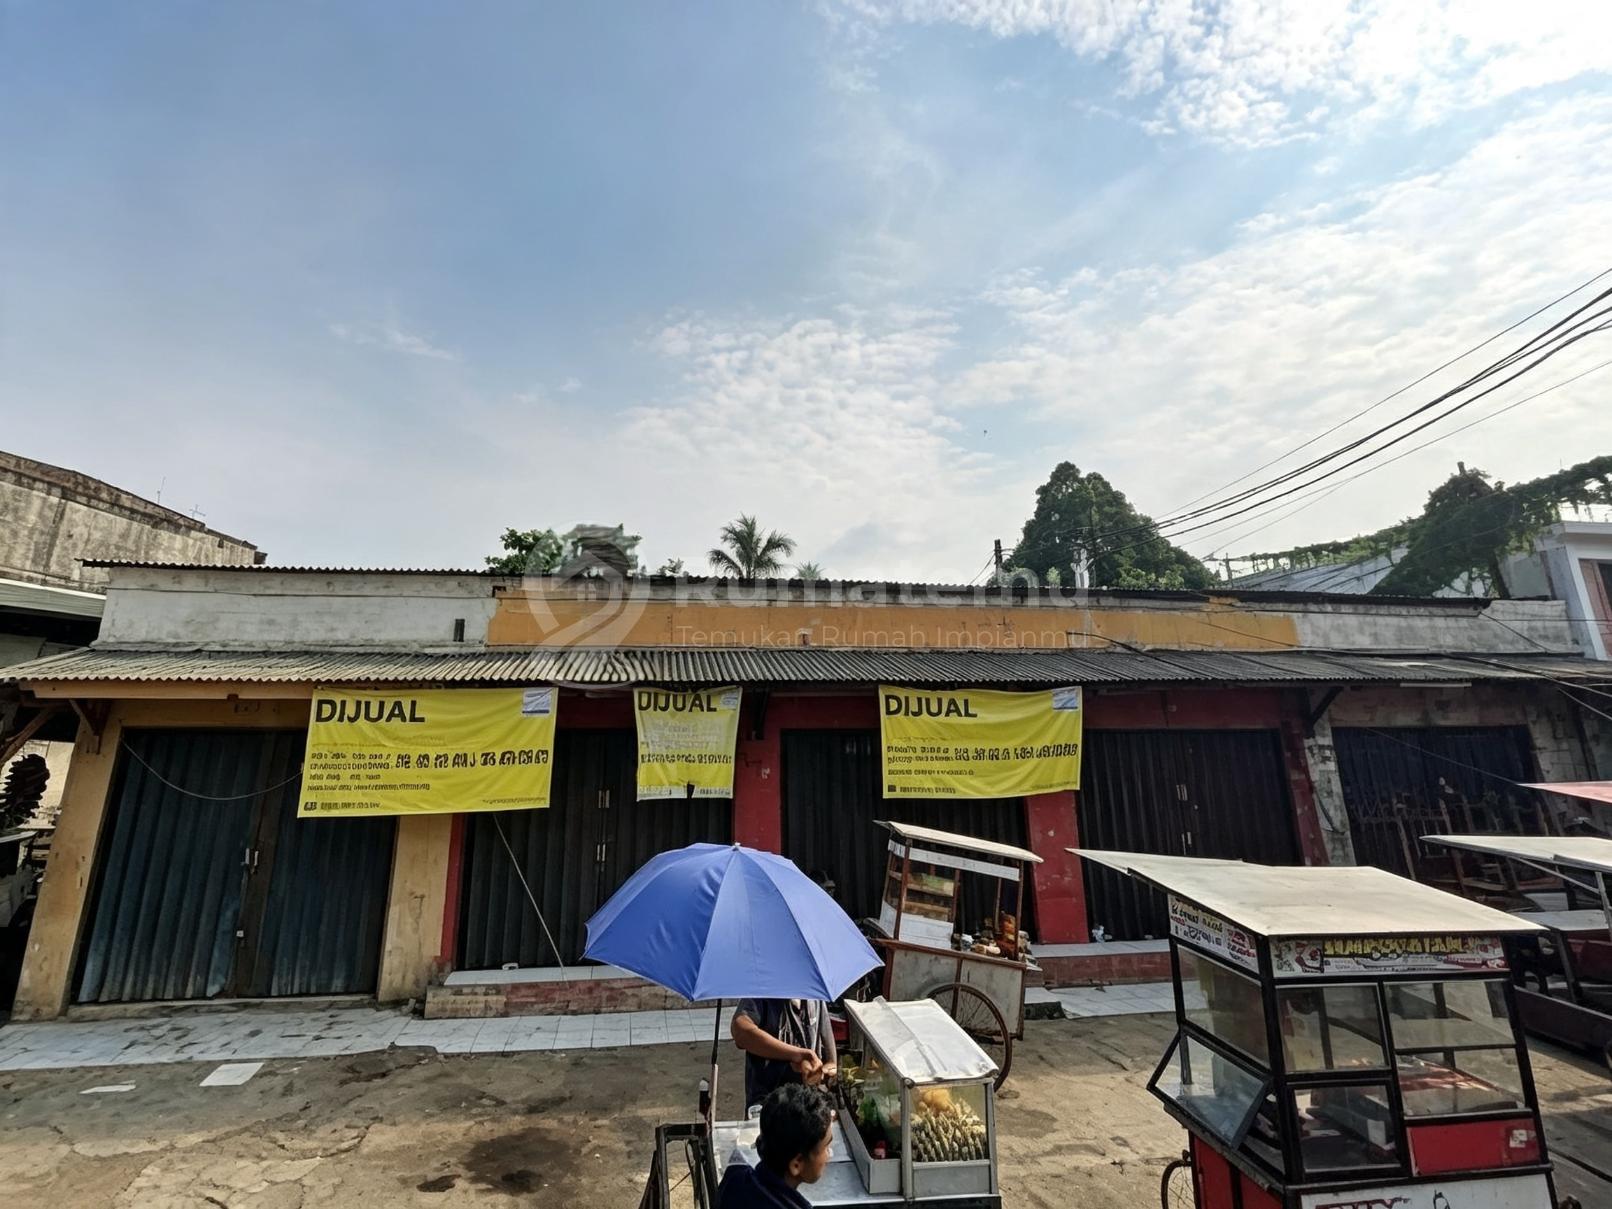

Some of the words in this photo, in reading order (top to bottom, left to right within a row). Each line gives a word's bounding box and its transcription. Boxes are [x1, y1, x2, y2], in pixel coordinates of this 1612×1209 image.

[315, 698, 425, 723] DIJUAL
[638, 691, 717, 712] DIJUAL
[885, 694, 978, 718] DIJUAL
